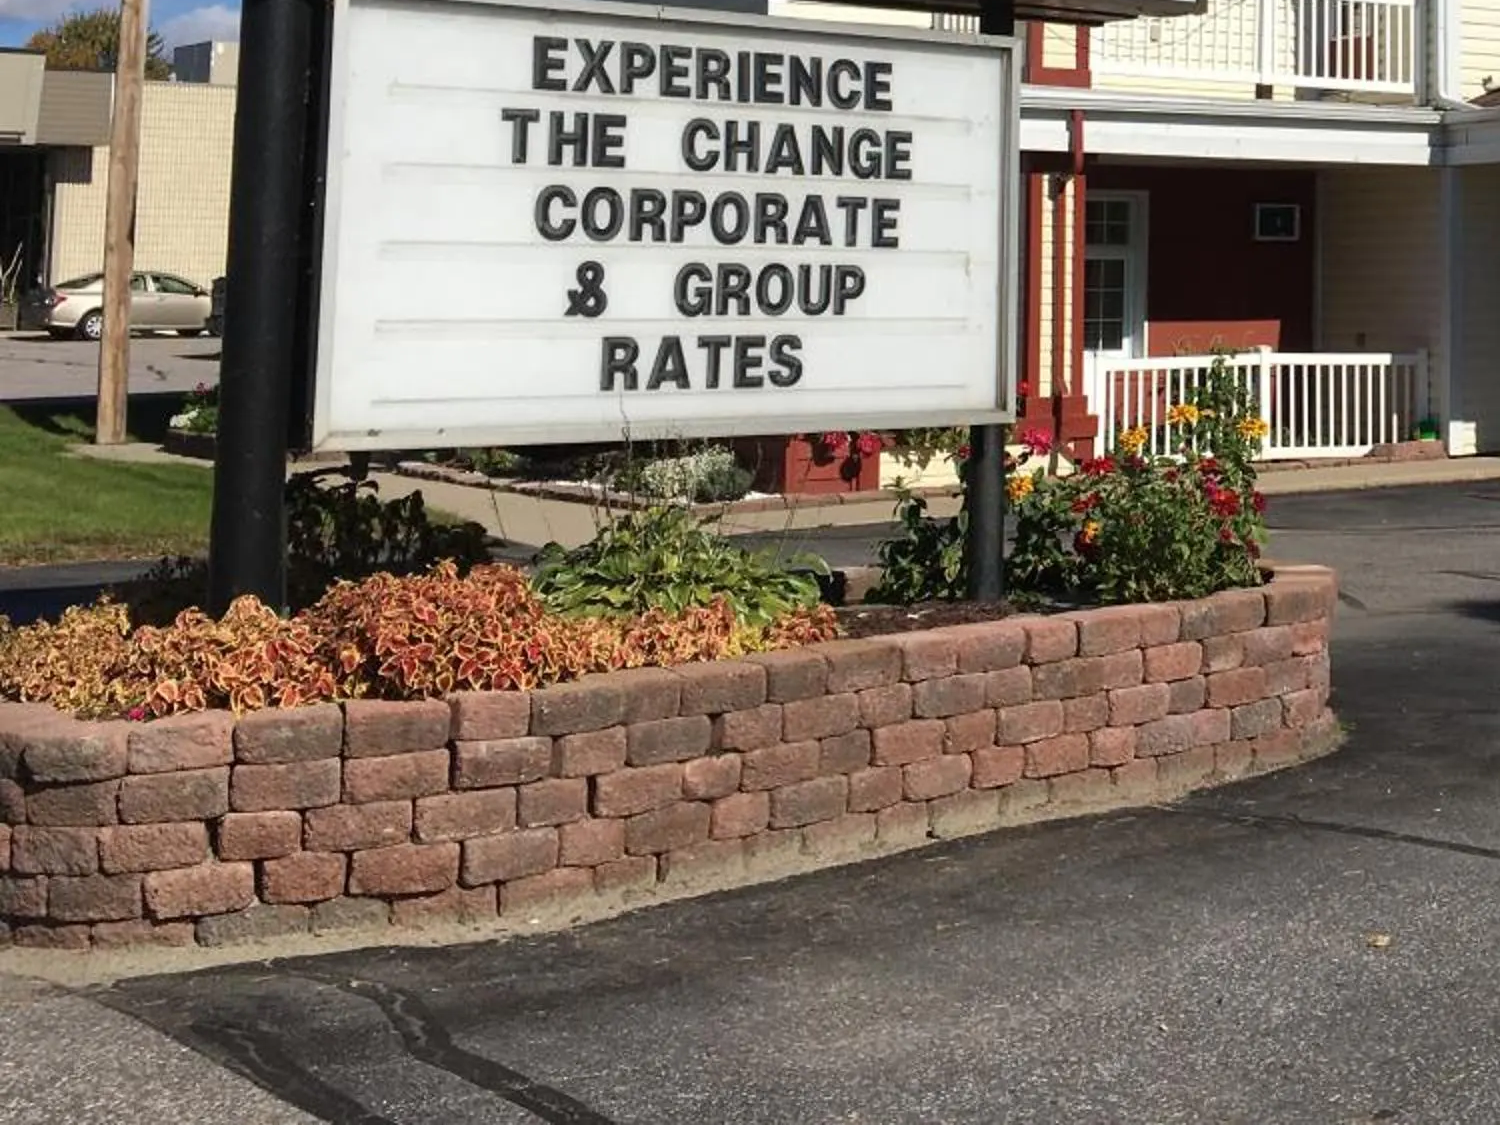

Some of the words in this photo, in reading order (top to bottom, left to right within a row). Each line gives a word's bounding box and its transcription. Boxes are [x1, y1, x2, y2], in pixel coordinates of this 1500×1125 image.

[531, 35, 894, 113] EXPERIENCE
[501, 107, 628, 169] THE
[681, 117, 914, 181] CHANGE
[535, 183, 901, 250] CORPORATE
[563, 259, 608, 319] &
[673, 261, 867, 319] GROUP
[599, 333, 804, 392] RATES
